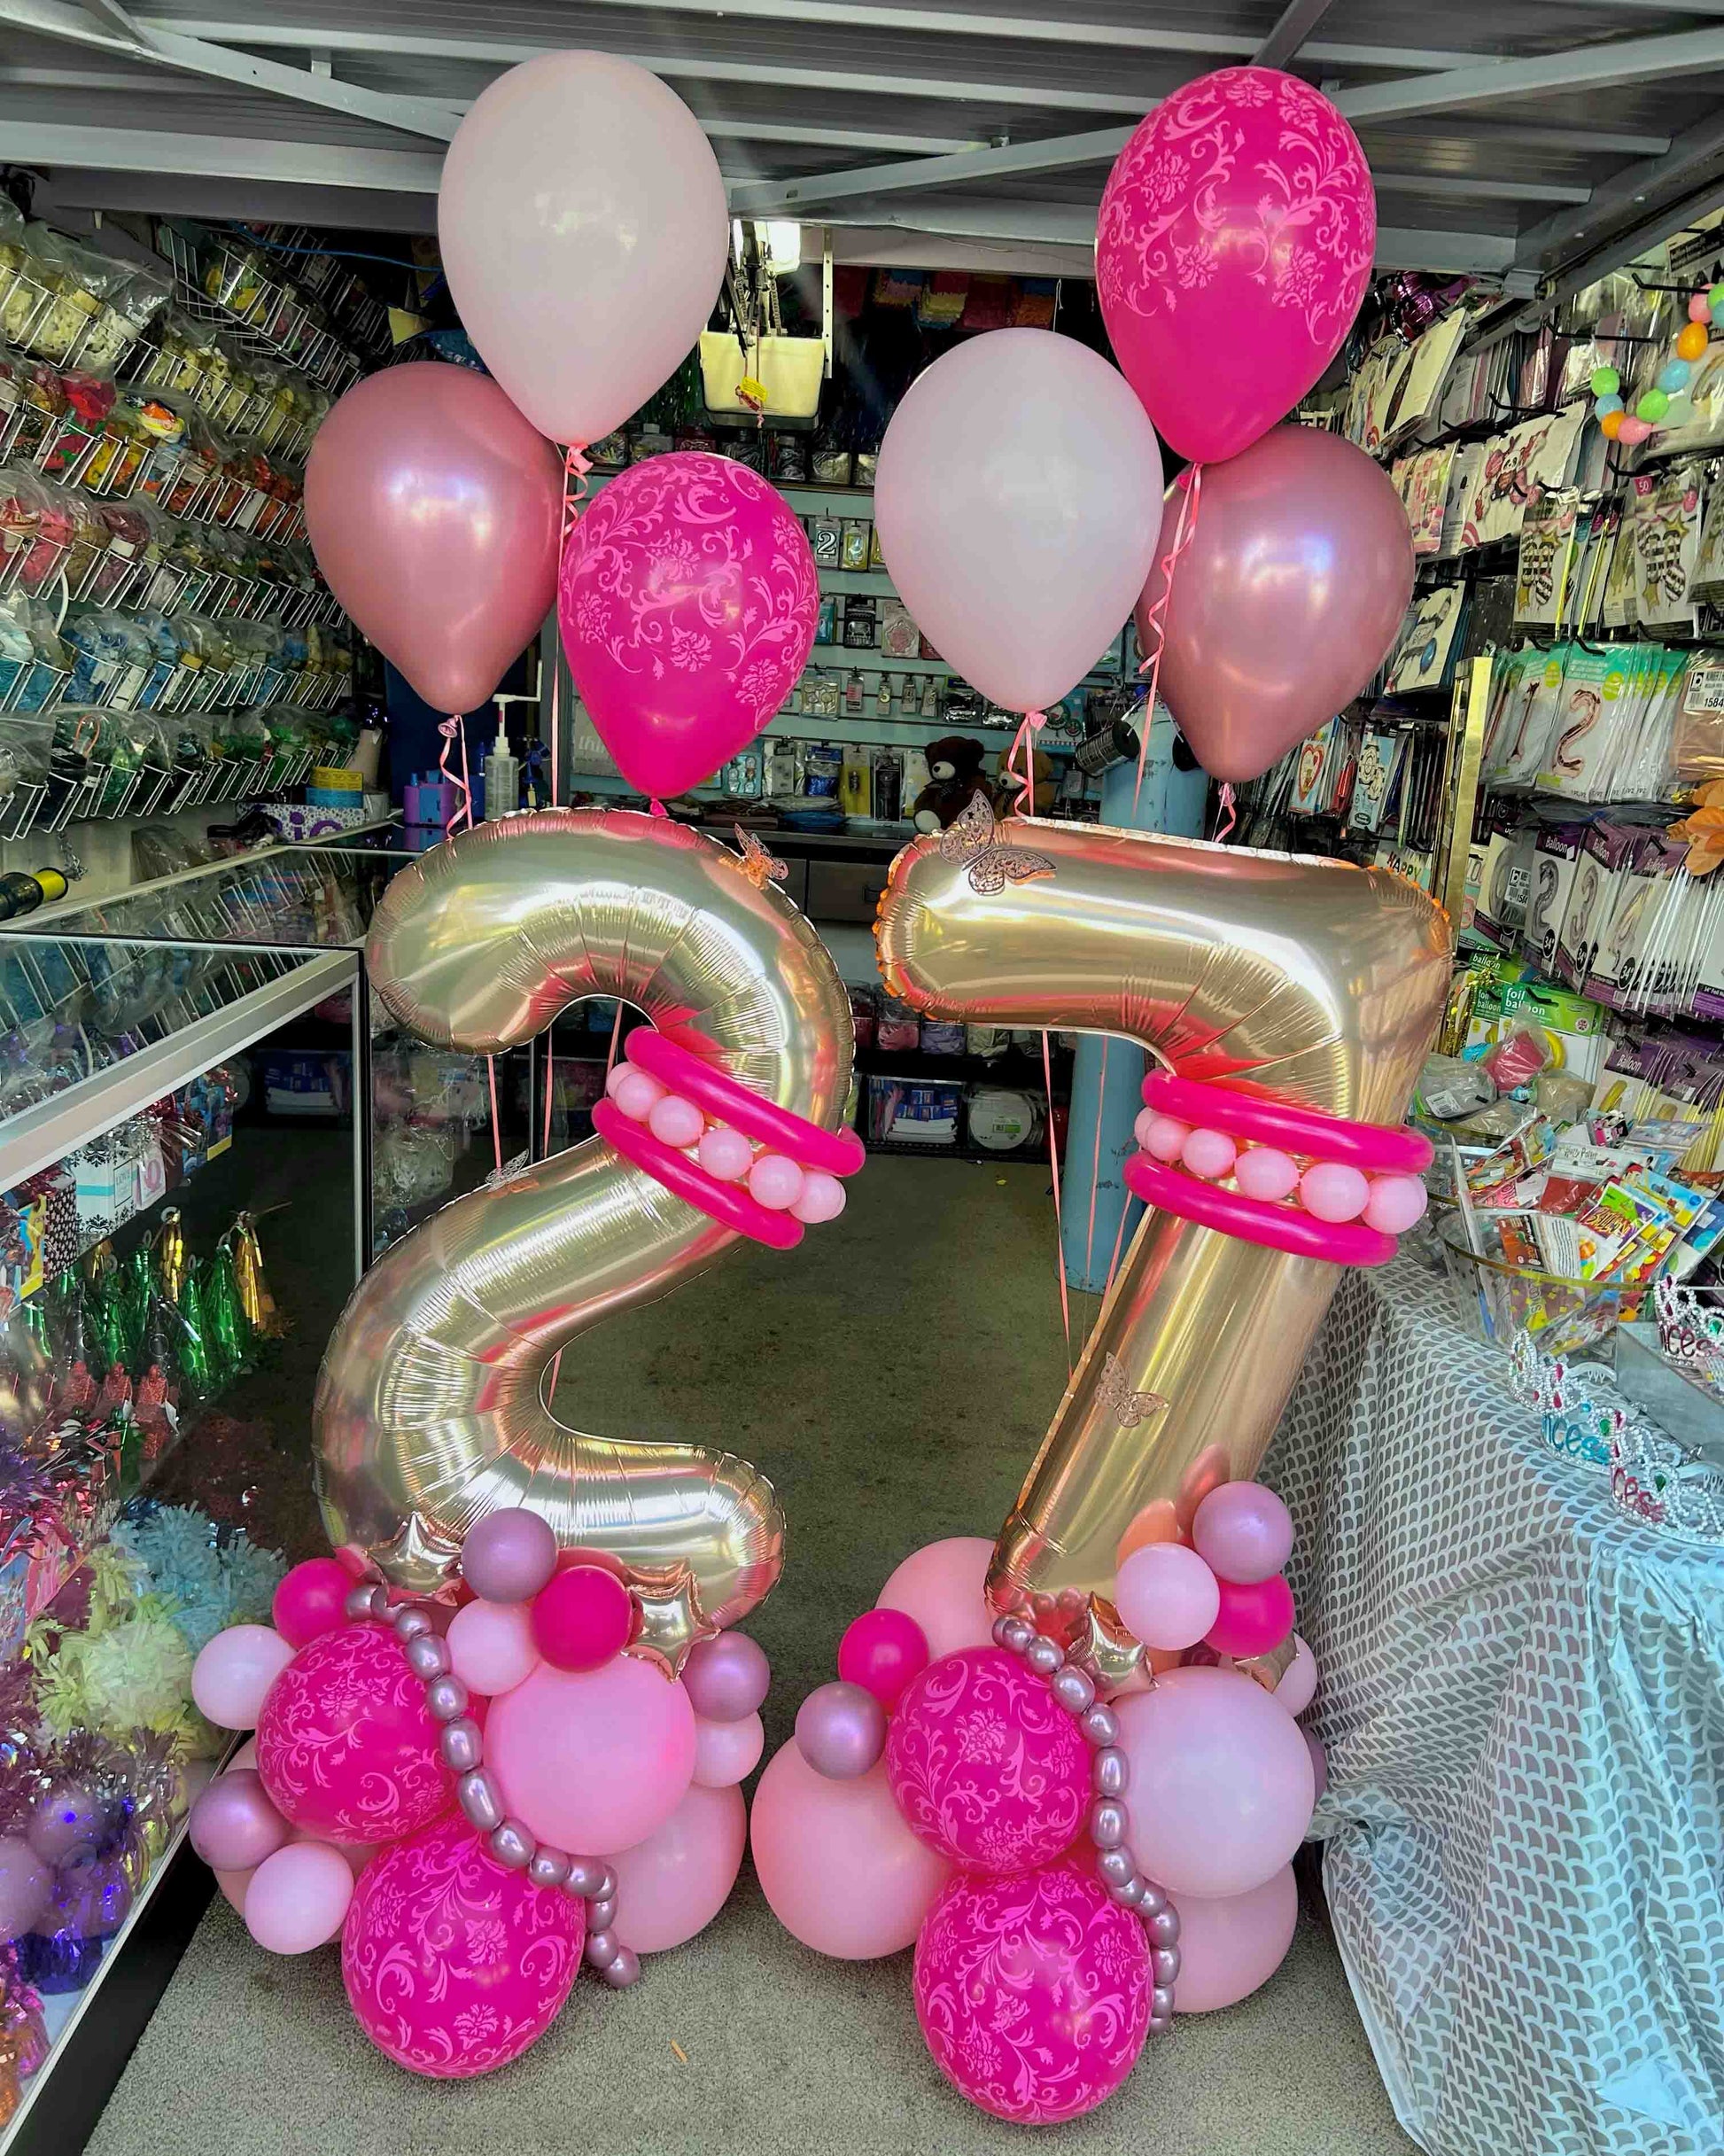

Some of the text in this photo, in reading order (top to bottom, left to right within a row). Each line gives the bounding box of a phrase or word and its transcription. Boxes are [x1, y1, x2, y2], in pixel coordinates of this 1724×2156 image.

[816, 530, 837, 556] 2
[1545, 836, 1568, 853] Balloon
[1507, 987, 1526, 1000] foil
[1505, 997, 1546, 1016] balon
[1617, 1054, 1642, 1071] Balloon
